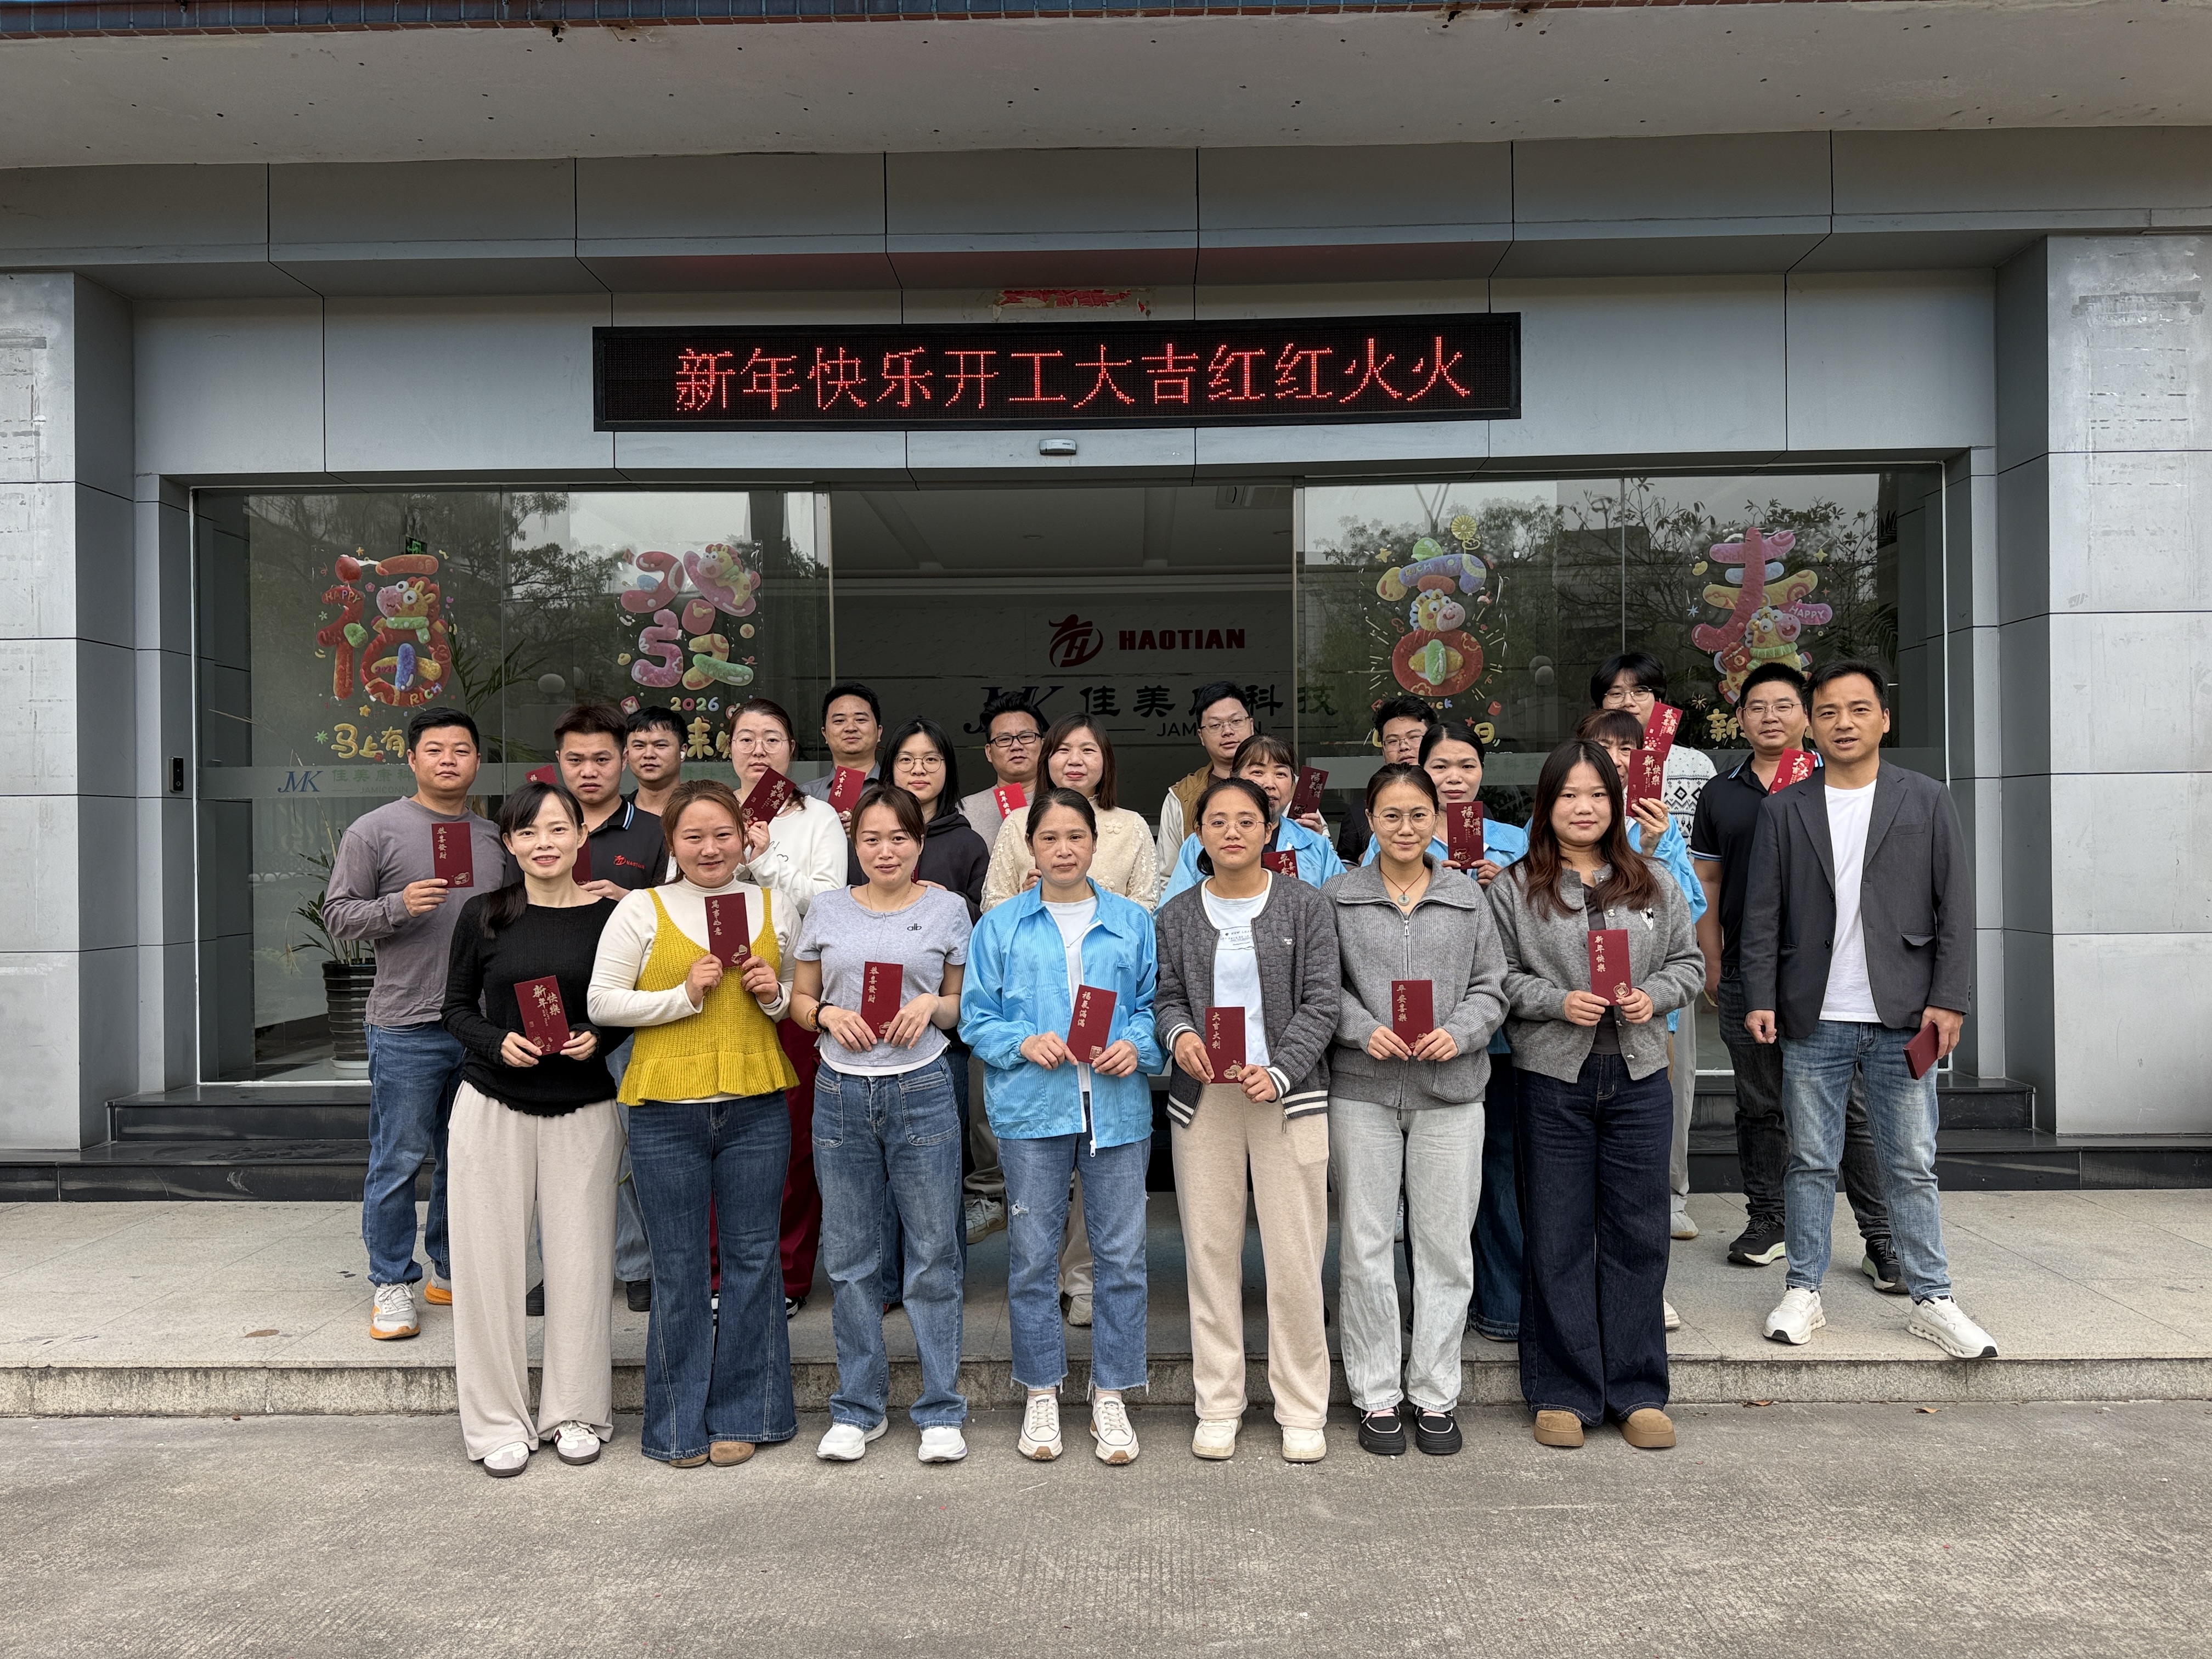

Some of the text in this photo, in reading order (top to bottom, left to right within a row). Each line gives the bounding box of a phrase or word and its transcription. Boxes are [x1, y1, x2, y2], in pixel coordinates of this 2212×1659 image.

[676, 335, 1471, 412] 新年快乐开工大吉红红火火
[1404, 562, 1433, 577] RICH
[325, 589, 361, 603] HAPPY
[1788, 605, 1825, 619] HAPPY
[1119, 628, 1245, 651] HAOTIAN
[670, 696, 720, 712] 2026
[1079, 684, 1338, 718] 佳美科技
[330, 722, 406, 759] 马上有
[359, 786, 409, 794] JAMICONN
[833, 770, 848, 798] 大吉大利
[1484, 775, 1515, 783] ICONN
[1594, 935, 1606, 973] 新年快樂
[867, 966, 879, 1003] 恭喜發財
[1396, 984, 1408, 1022] 平安喜樂
[1211, 1012, 1221, 1049] 大吉大利
